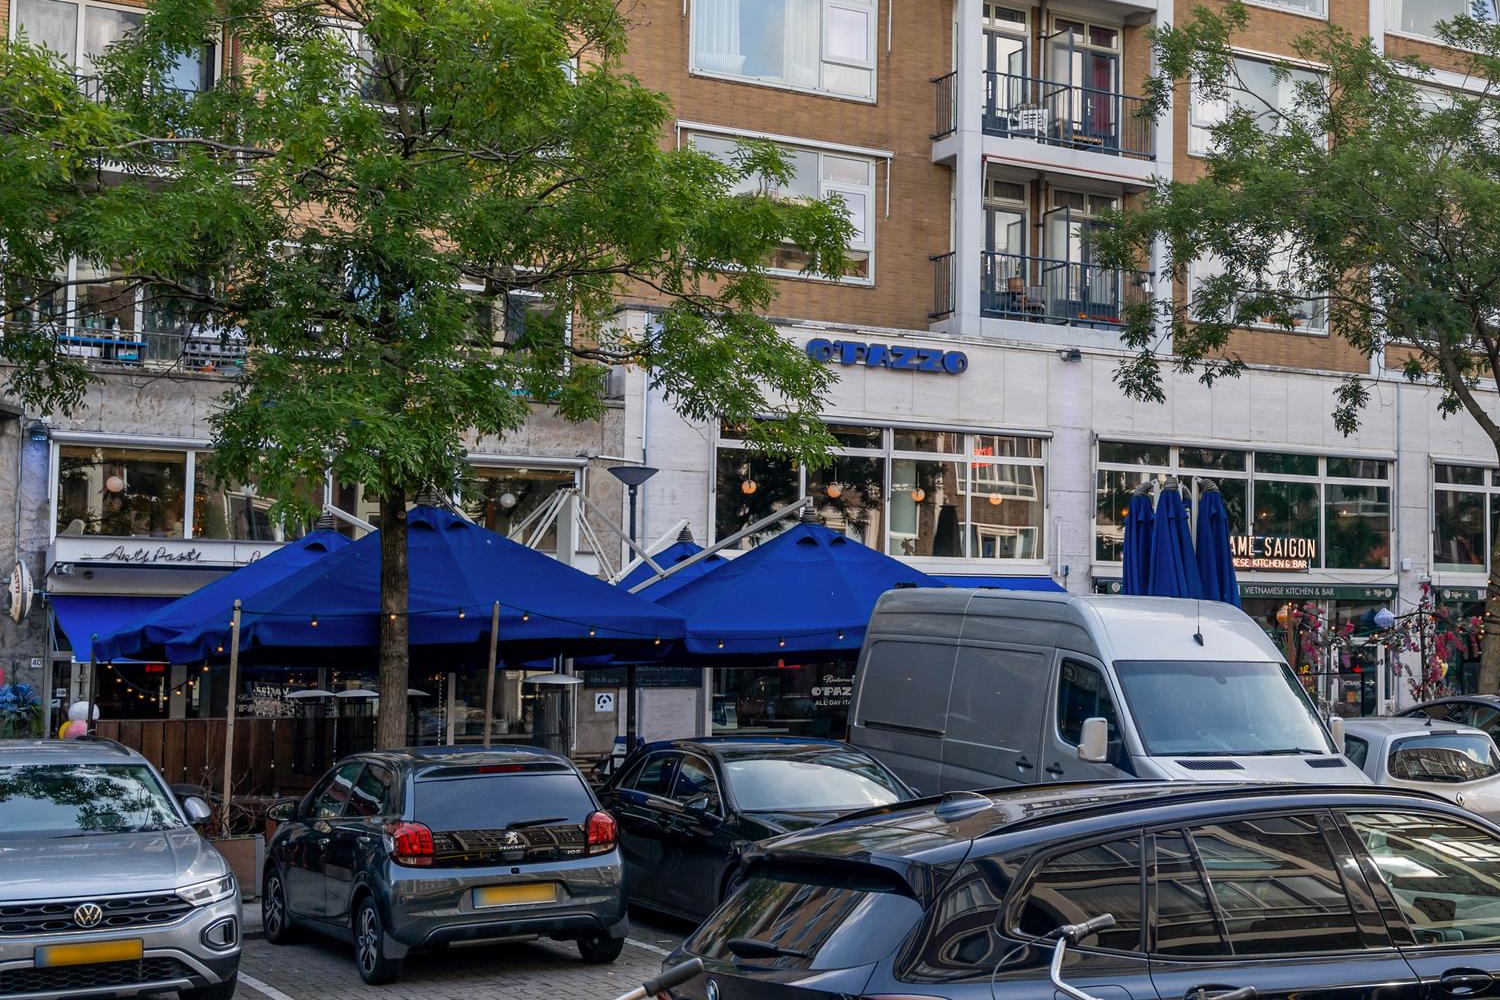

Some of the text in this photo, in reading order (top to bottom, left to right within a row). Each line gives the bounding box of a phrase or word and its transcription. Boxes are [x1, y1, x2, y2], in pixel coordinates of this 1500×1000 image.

[805, 337, 969, 375] O'PAZZO
[1264, 536, 1316, 558] SAIGON
[1252, 558, 1284, 568] KITCHEN
[1292, 560, 1308, 569] BAR
[1244, 586, 1285, 594] VIETNAMESE
[811, 686, 852, 696] O'PAZ
